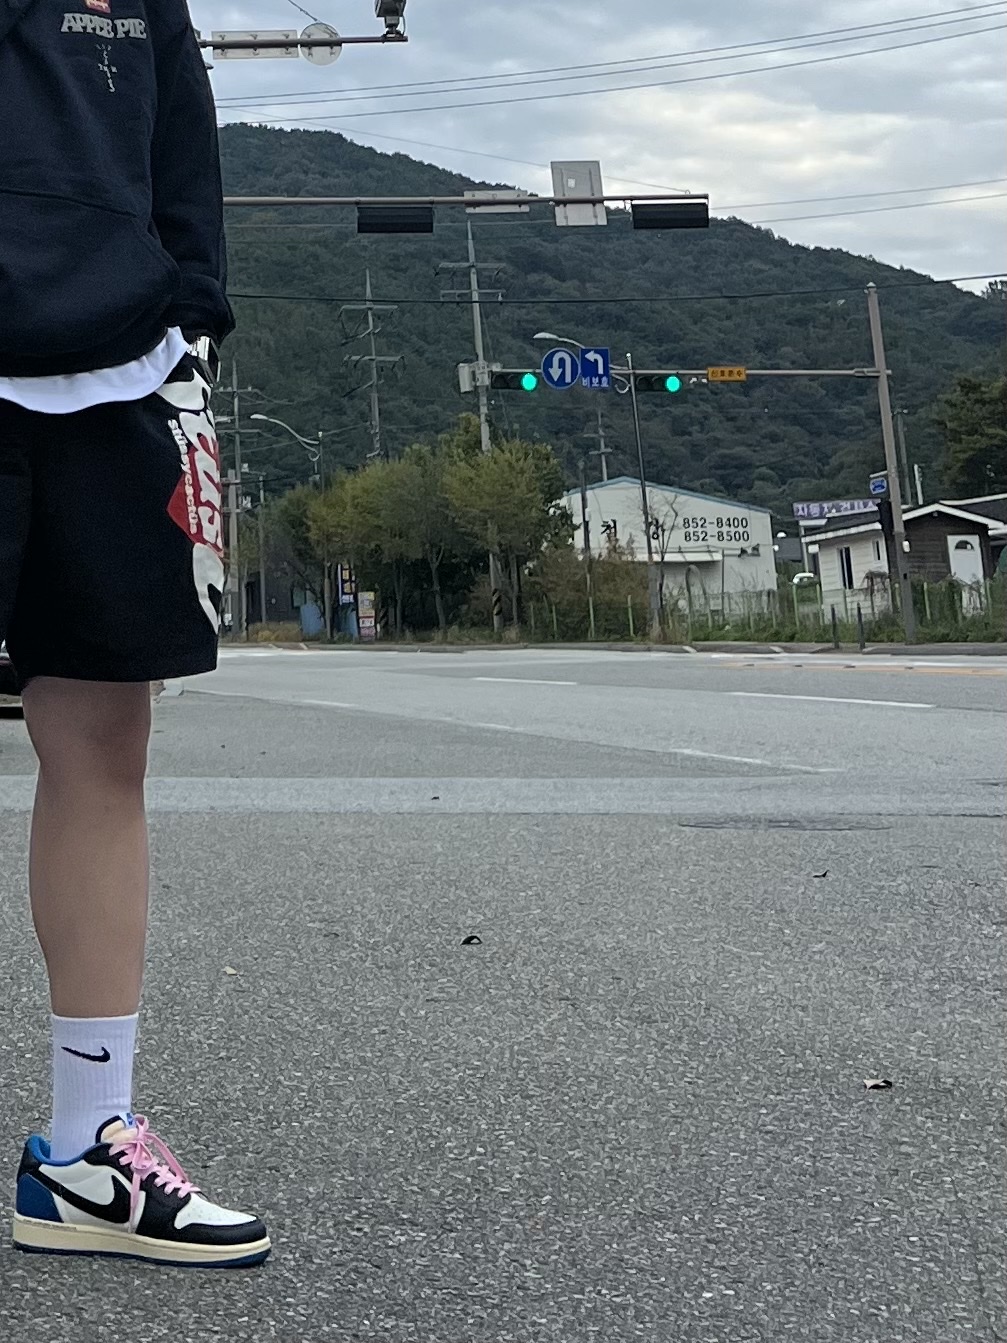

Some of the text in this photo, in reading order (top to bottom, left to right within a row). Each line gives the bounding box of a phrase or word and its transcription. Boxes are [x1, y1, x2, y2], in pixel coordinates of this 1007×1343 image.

[114, 18, 146, 39] PIE
[581, 375, 609, 388] 비보호
[682, 517, 749, 529] 852-8400
[684, 530, 750, 542] 852-8500
